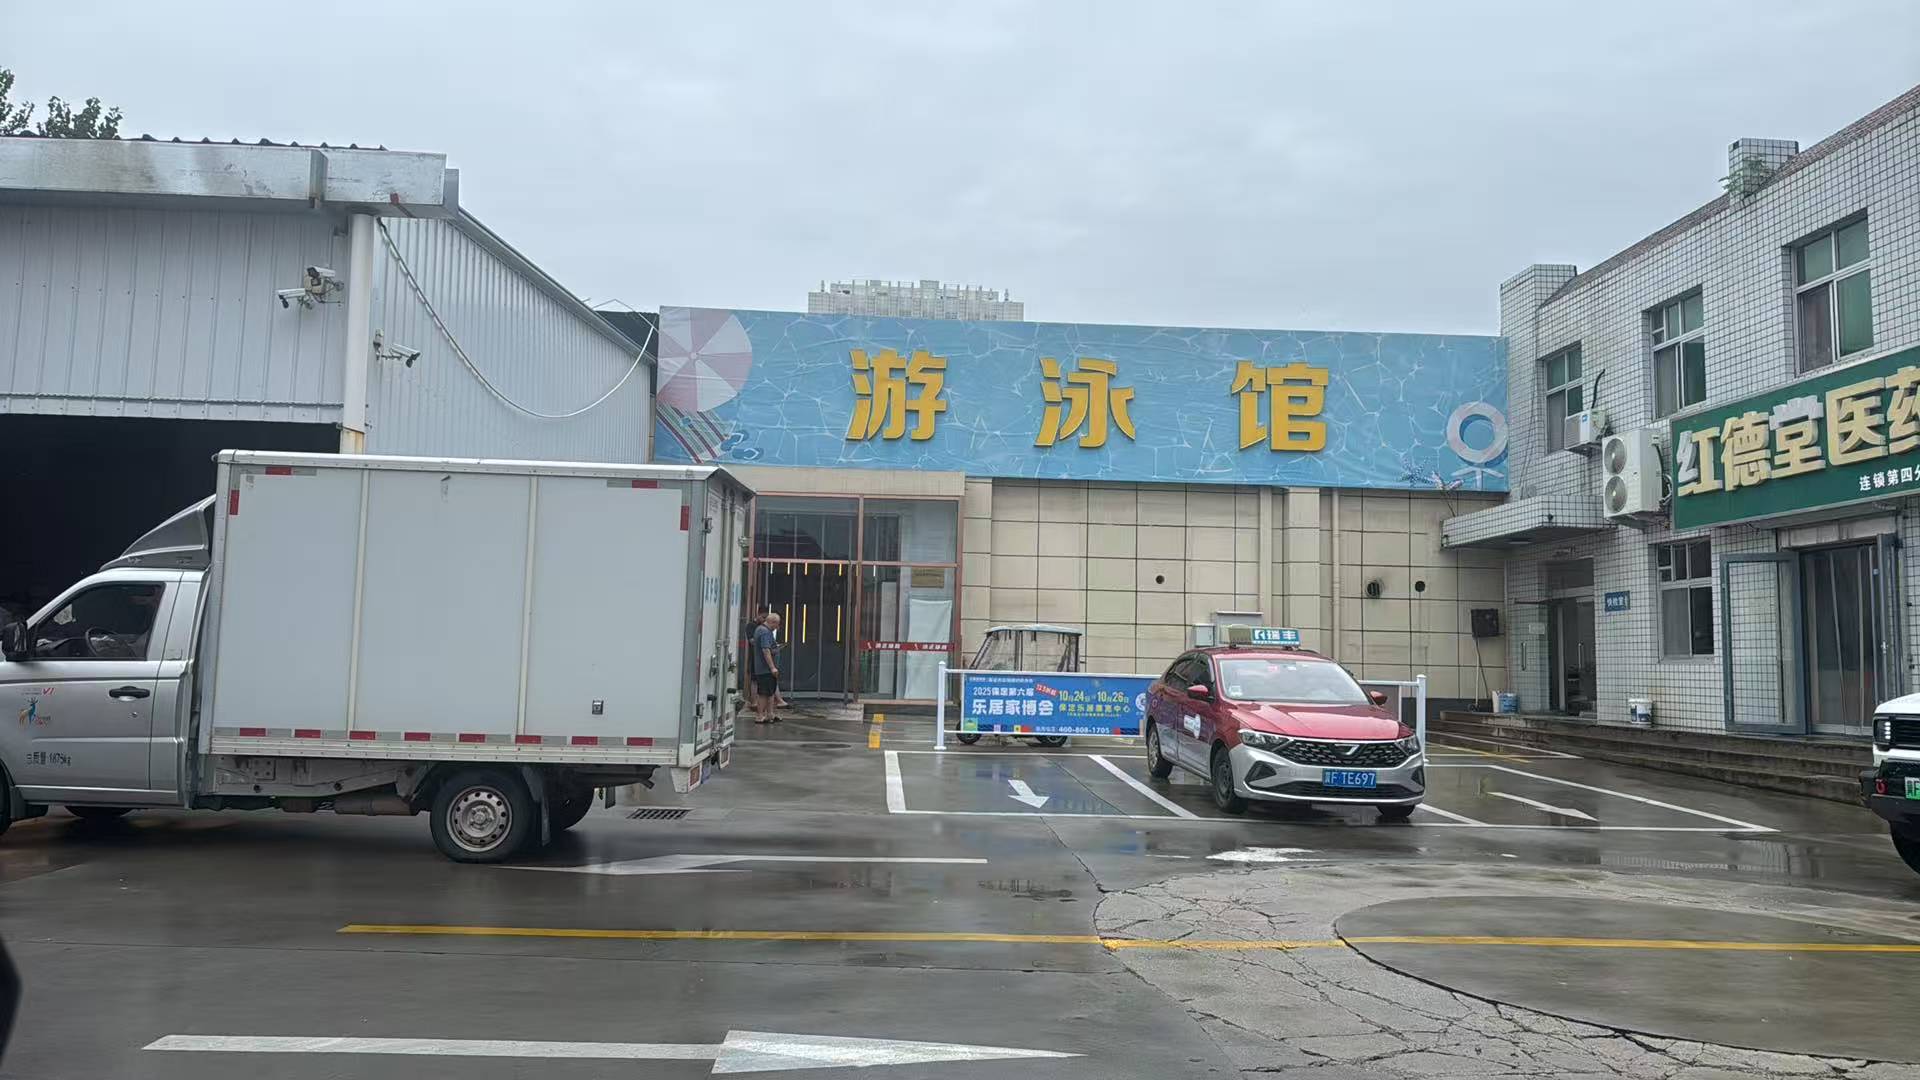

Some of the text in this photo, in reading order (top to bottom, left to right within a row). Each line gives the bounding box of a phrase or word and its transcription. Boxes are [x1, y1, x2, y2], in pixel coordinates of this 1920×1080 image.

[846, 348, 1329, 452] 游泳馆
[972, 699, 1053, 716] 乐居家博会
